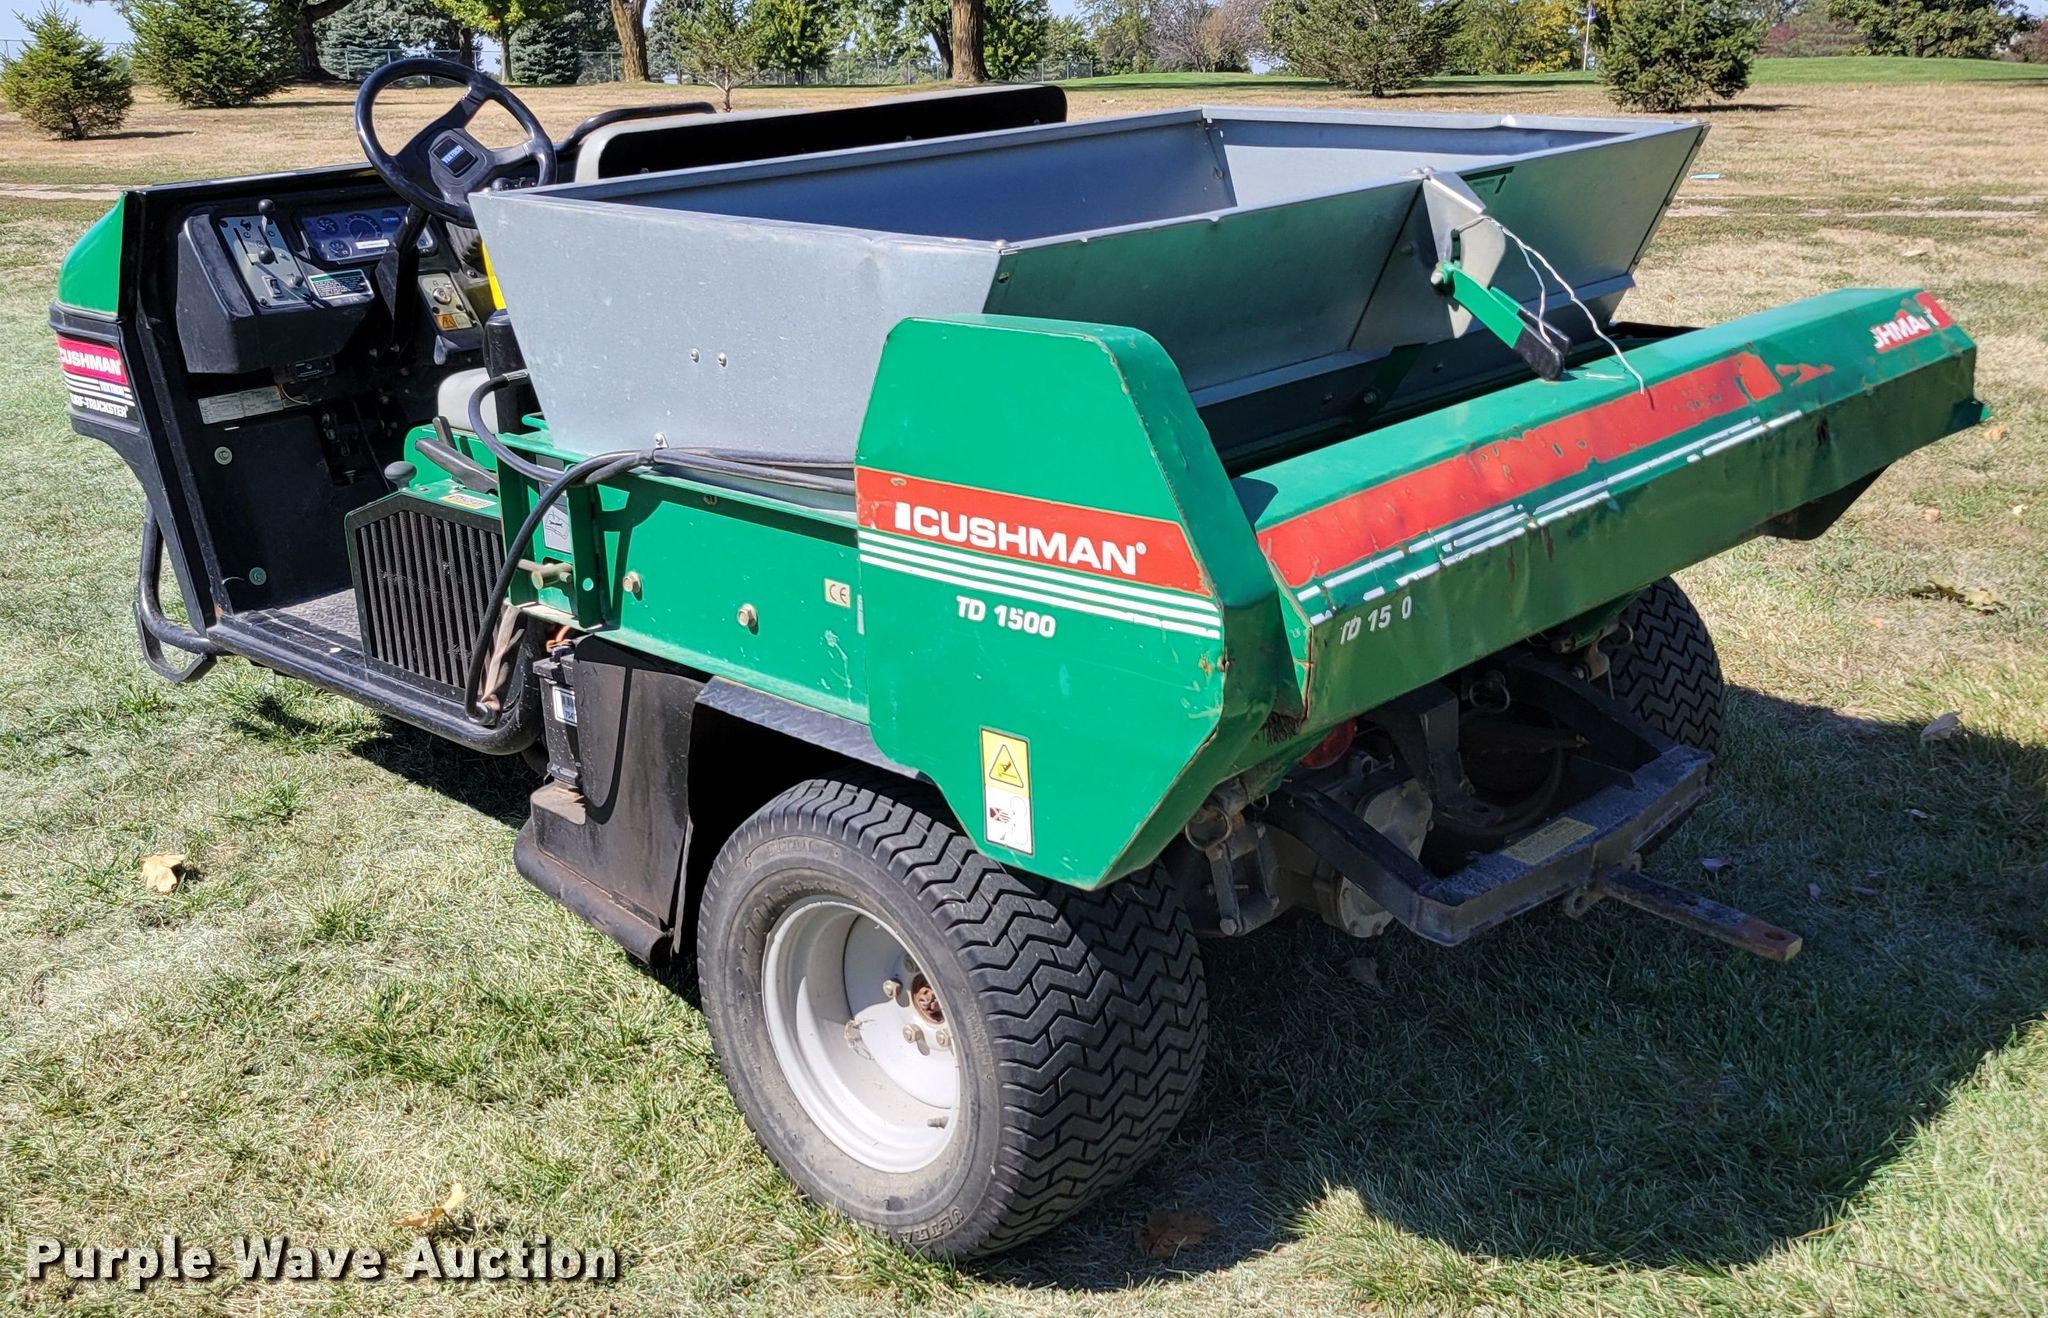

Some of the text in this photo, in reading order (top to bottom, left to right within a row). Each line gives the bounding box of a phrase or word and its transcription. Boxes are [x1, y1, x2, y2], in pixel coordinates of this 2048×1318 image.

[912, 505, 1137, 576] CUSHMAN
[956, 595, 1056, 638] TD 1500
